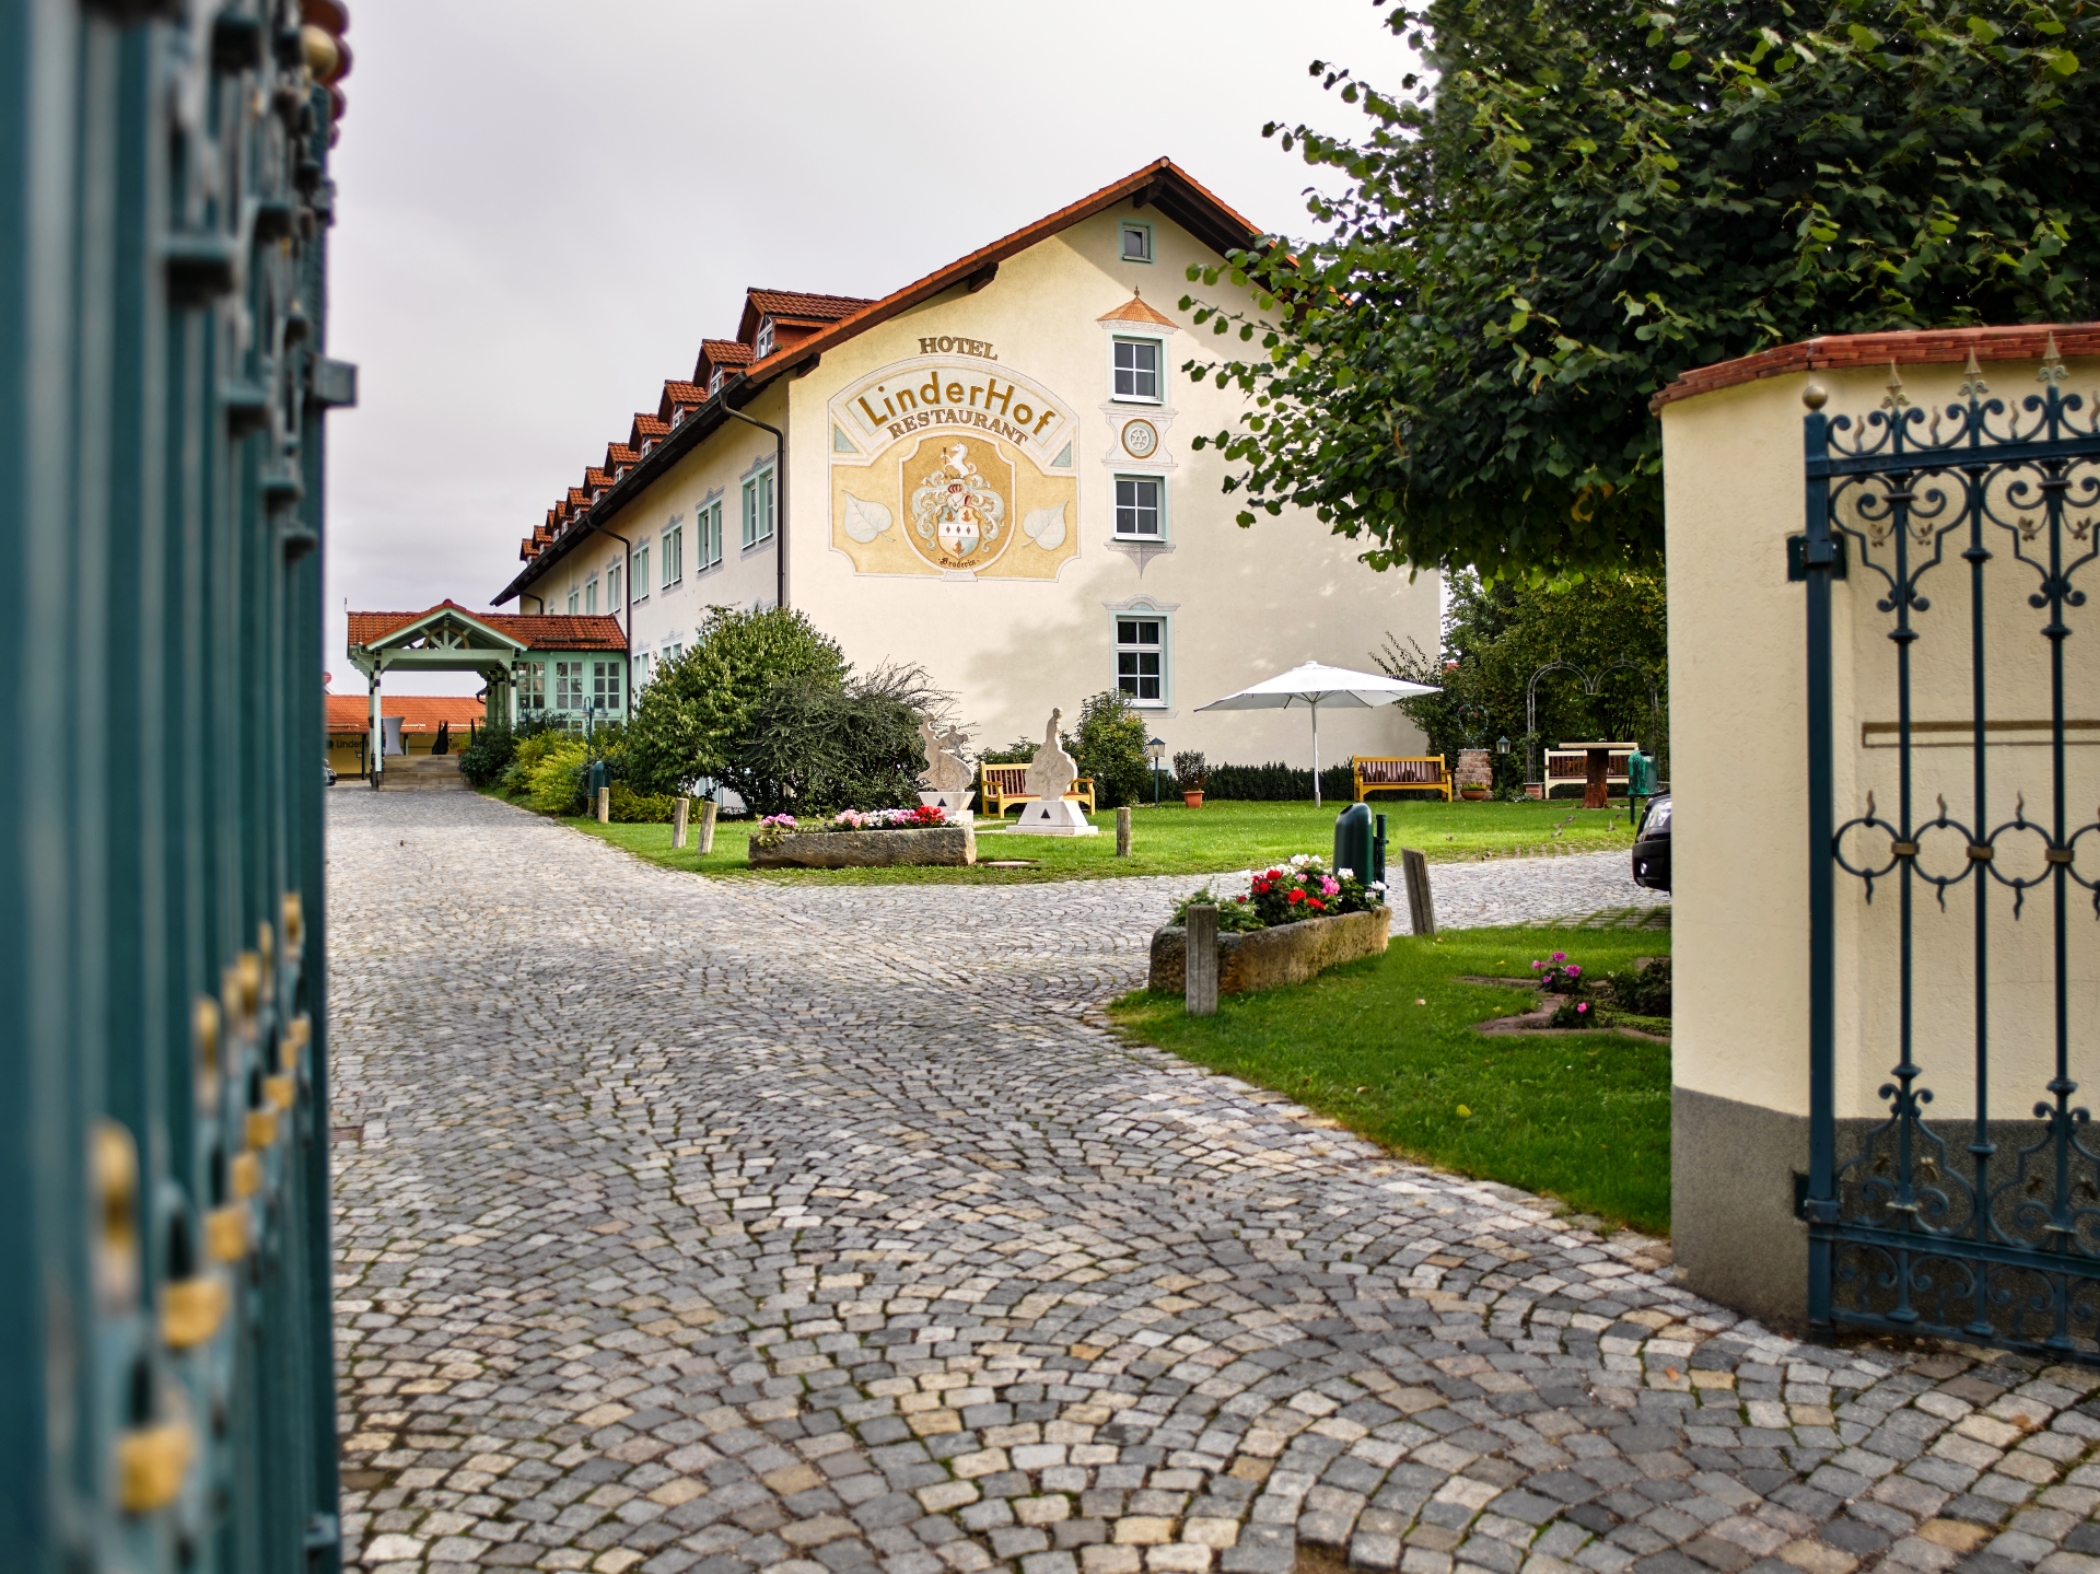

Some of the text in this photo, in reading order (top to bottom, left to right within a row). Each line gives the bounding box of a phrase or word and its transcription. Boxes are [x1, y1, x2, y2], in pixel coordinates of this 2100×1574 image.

[917, 335, 998, 361] HOTEL
[857, 371, 1056, 435] LinderHof
[886, 408, 1029, 446] RESTAURANT
